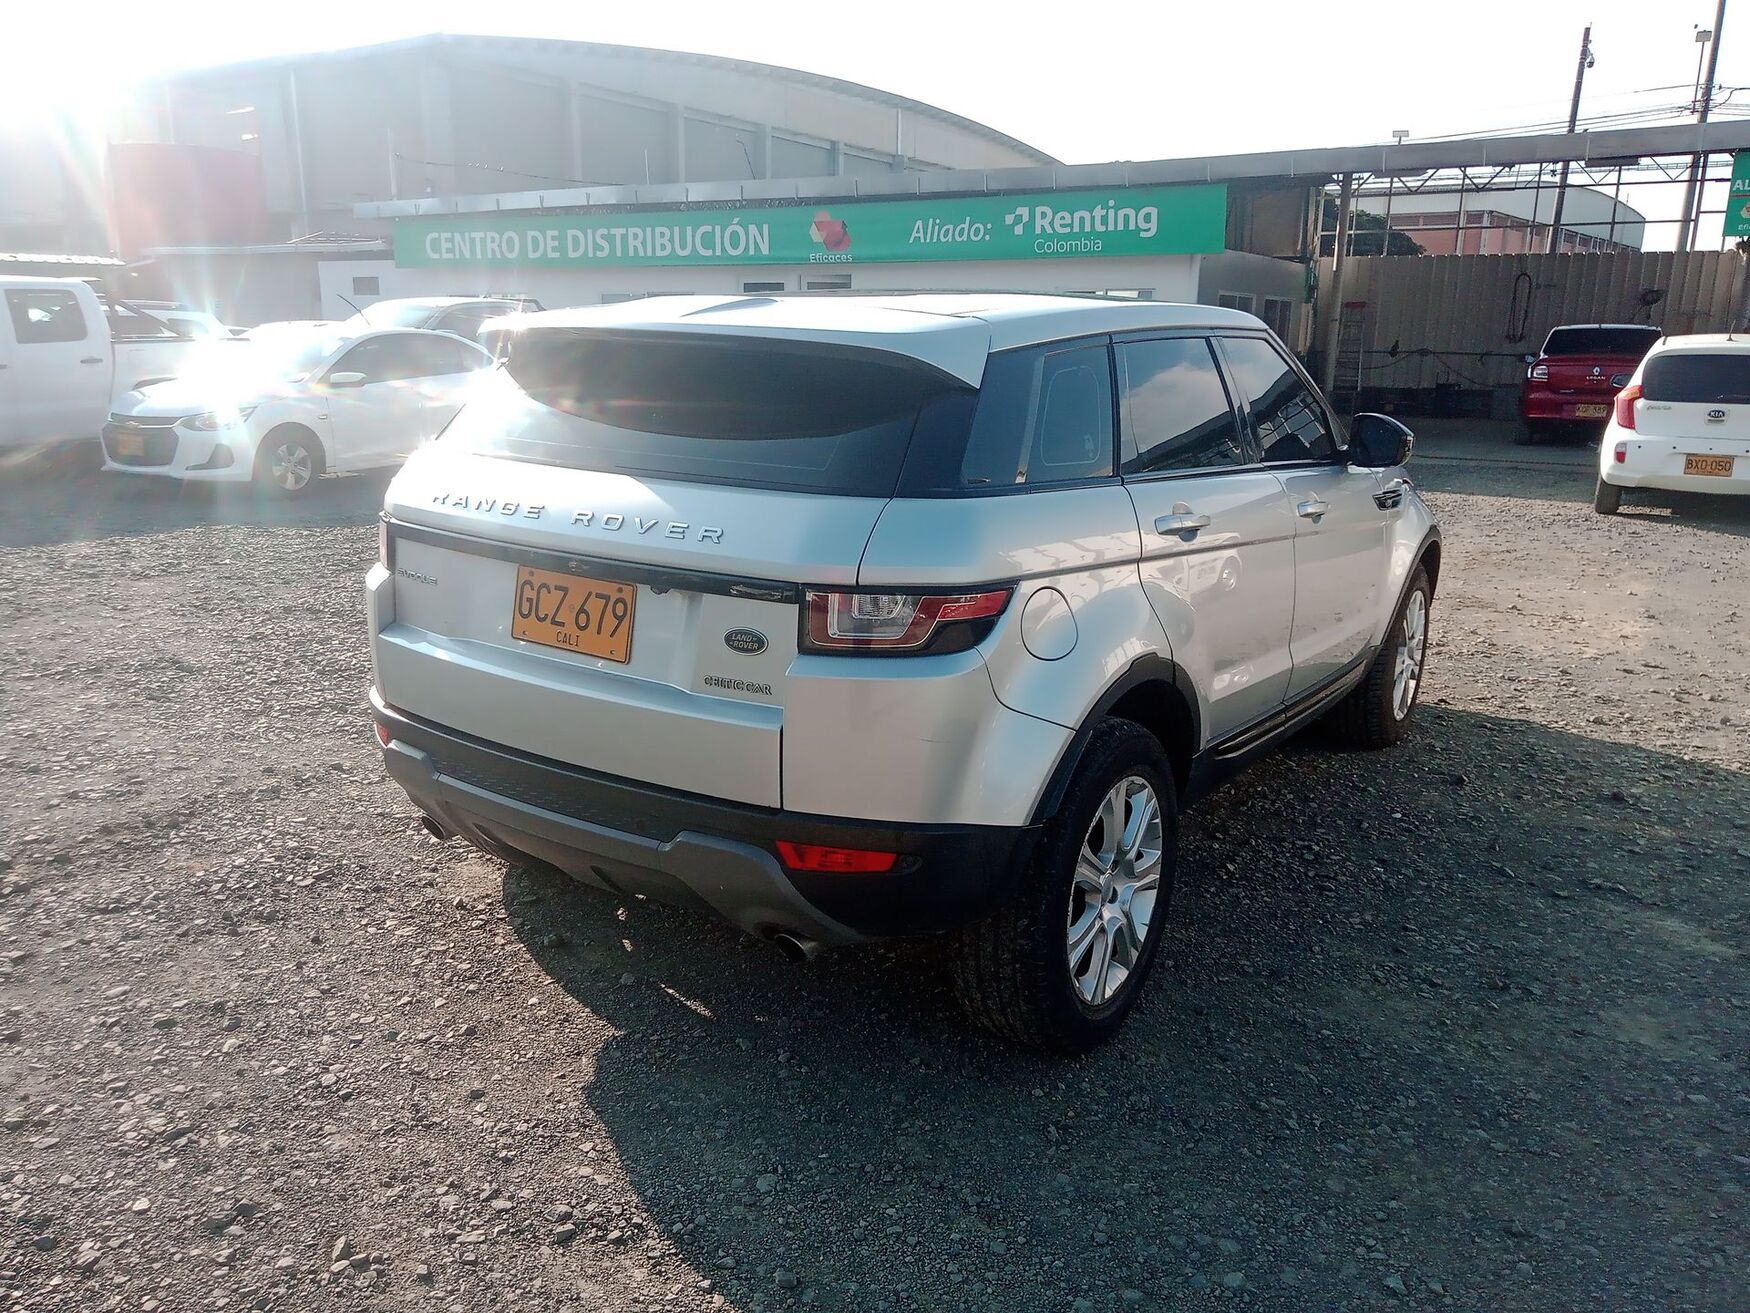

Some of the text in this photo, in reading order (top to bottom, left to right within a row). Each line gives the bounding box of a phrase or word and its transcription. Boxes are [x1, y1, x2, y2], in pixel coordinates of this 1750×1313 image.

[1034, 199, 1158, 238] Renting
[425, 217, 770, 260] CENTRO DE DISTRIBUCIÓN
[909, 216, 992, 244] Aliado:
[1034, 237, 1102, 254] Colombia
[809, 252, 853, 263] Eficaces
[1710, 410, 1725, 418] KIA
[432, 494, 725, 545] RANGE ROVER
[518, 579, 629, 638] GCZ 679
[556, 630, 581, 647] CALI
[731, 633, 752, 642] LAND
[733, 640, 759, 650] ROVER
